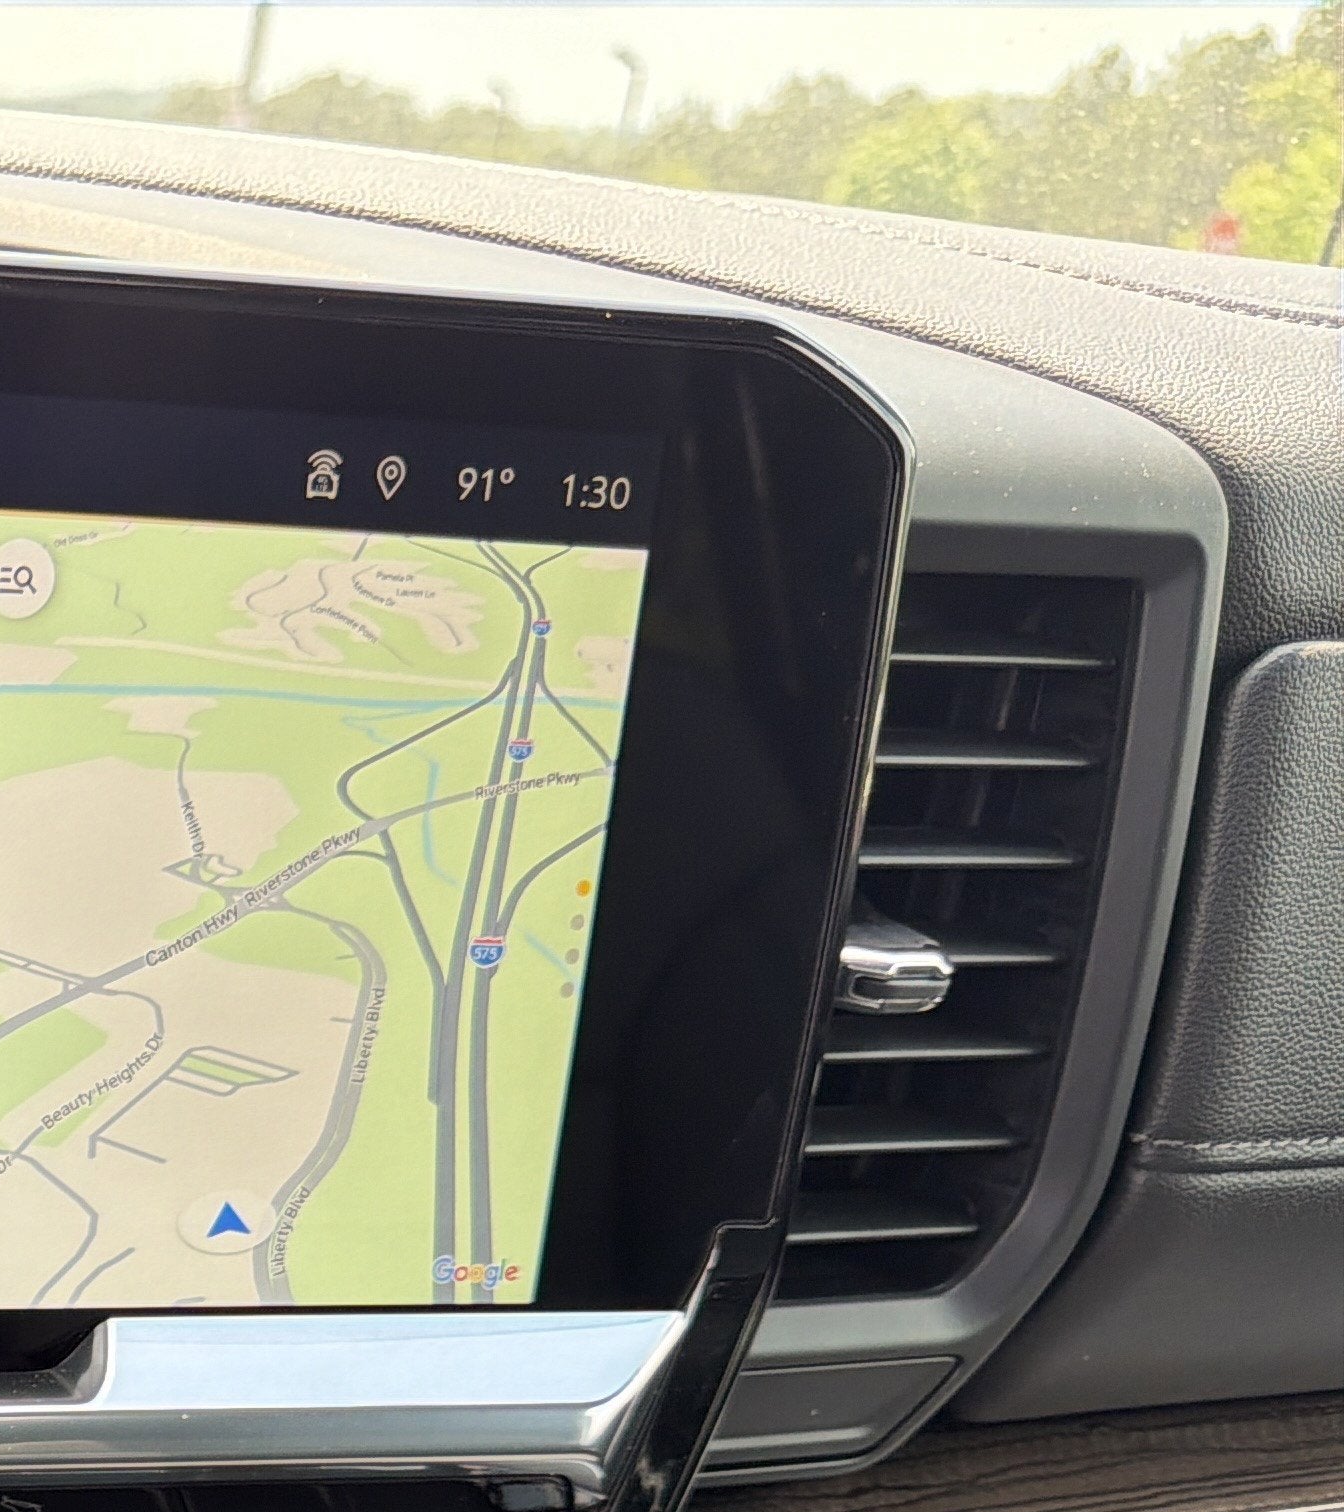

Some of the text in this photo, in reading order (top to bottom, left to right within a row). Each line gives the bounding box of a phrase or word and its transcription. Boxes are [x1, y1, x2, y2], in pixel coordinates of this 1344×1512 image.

[457, 467, 515, 502] 91°
[562, 474, 631, 510] 1:30
[474, 771, 582, 800] Riverstone Pkwy
[180, 800, 207, 859] Keith Dr
[244, 826, 363, 907] Riverstone Pkwy
[145, 904, 240, 967] Canton Hwy
[473, 946, 498, 961] 575
[350, 987, 386, 1084] Liberty Blvd
[40, 1031, 165, 1131] Beauty Heights Dr
[272, 1186, 311, 1279] Liberty Blvd
[432, 1255, 521, 1291] Google
